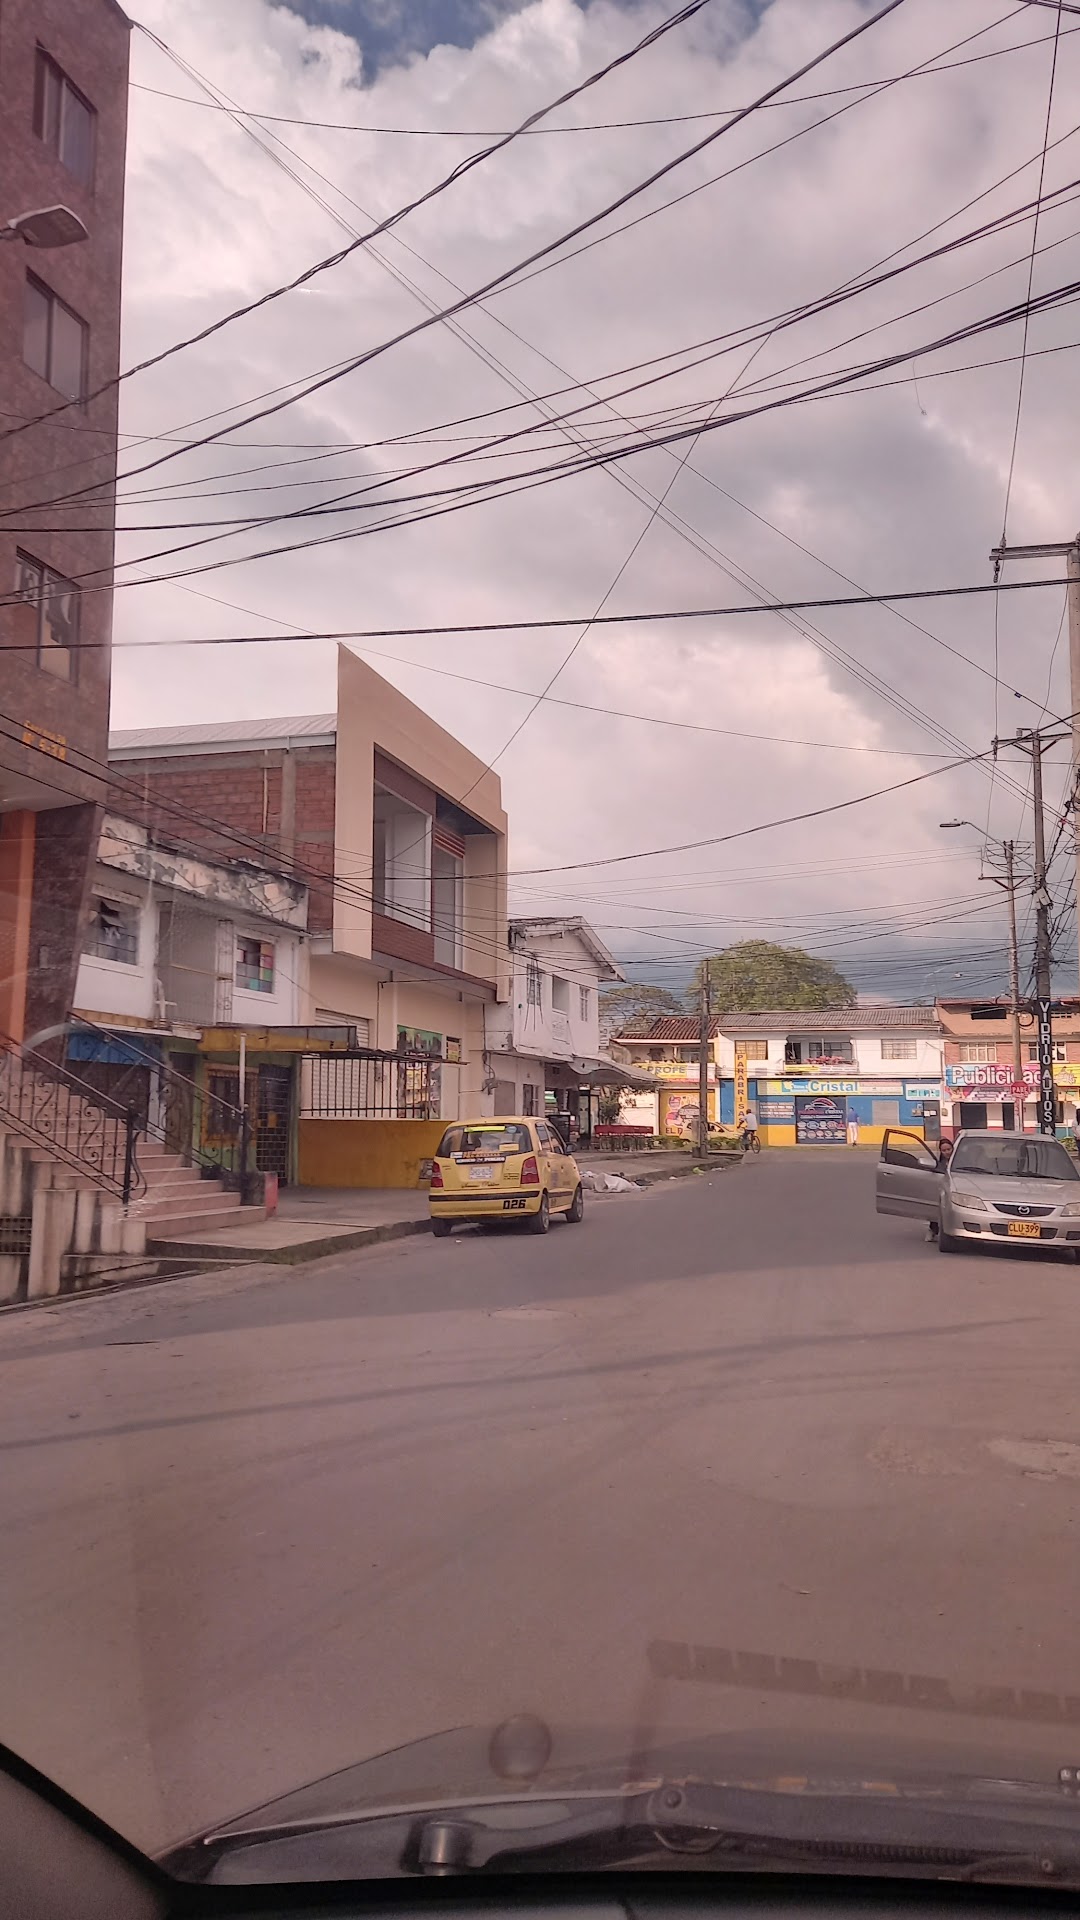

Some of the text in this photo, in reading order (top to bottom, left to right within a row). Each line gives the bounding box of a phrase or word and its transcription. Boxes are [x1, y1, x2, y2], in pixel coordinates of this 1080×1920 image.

[1040, 1001, 1053, 1122] VIDRIO AUTOS
[810, 1080, 858, 1092] Cristal
[1012, 1086, 1028, 1094] PARE
[503, 1199, 526, 1210] 026
